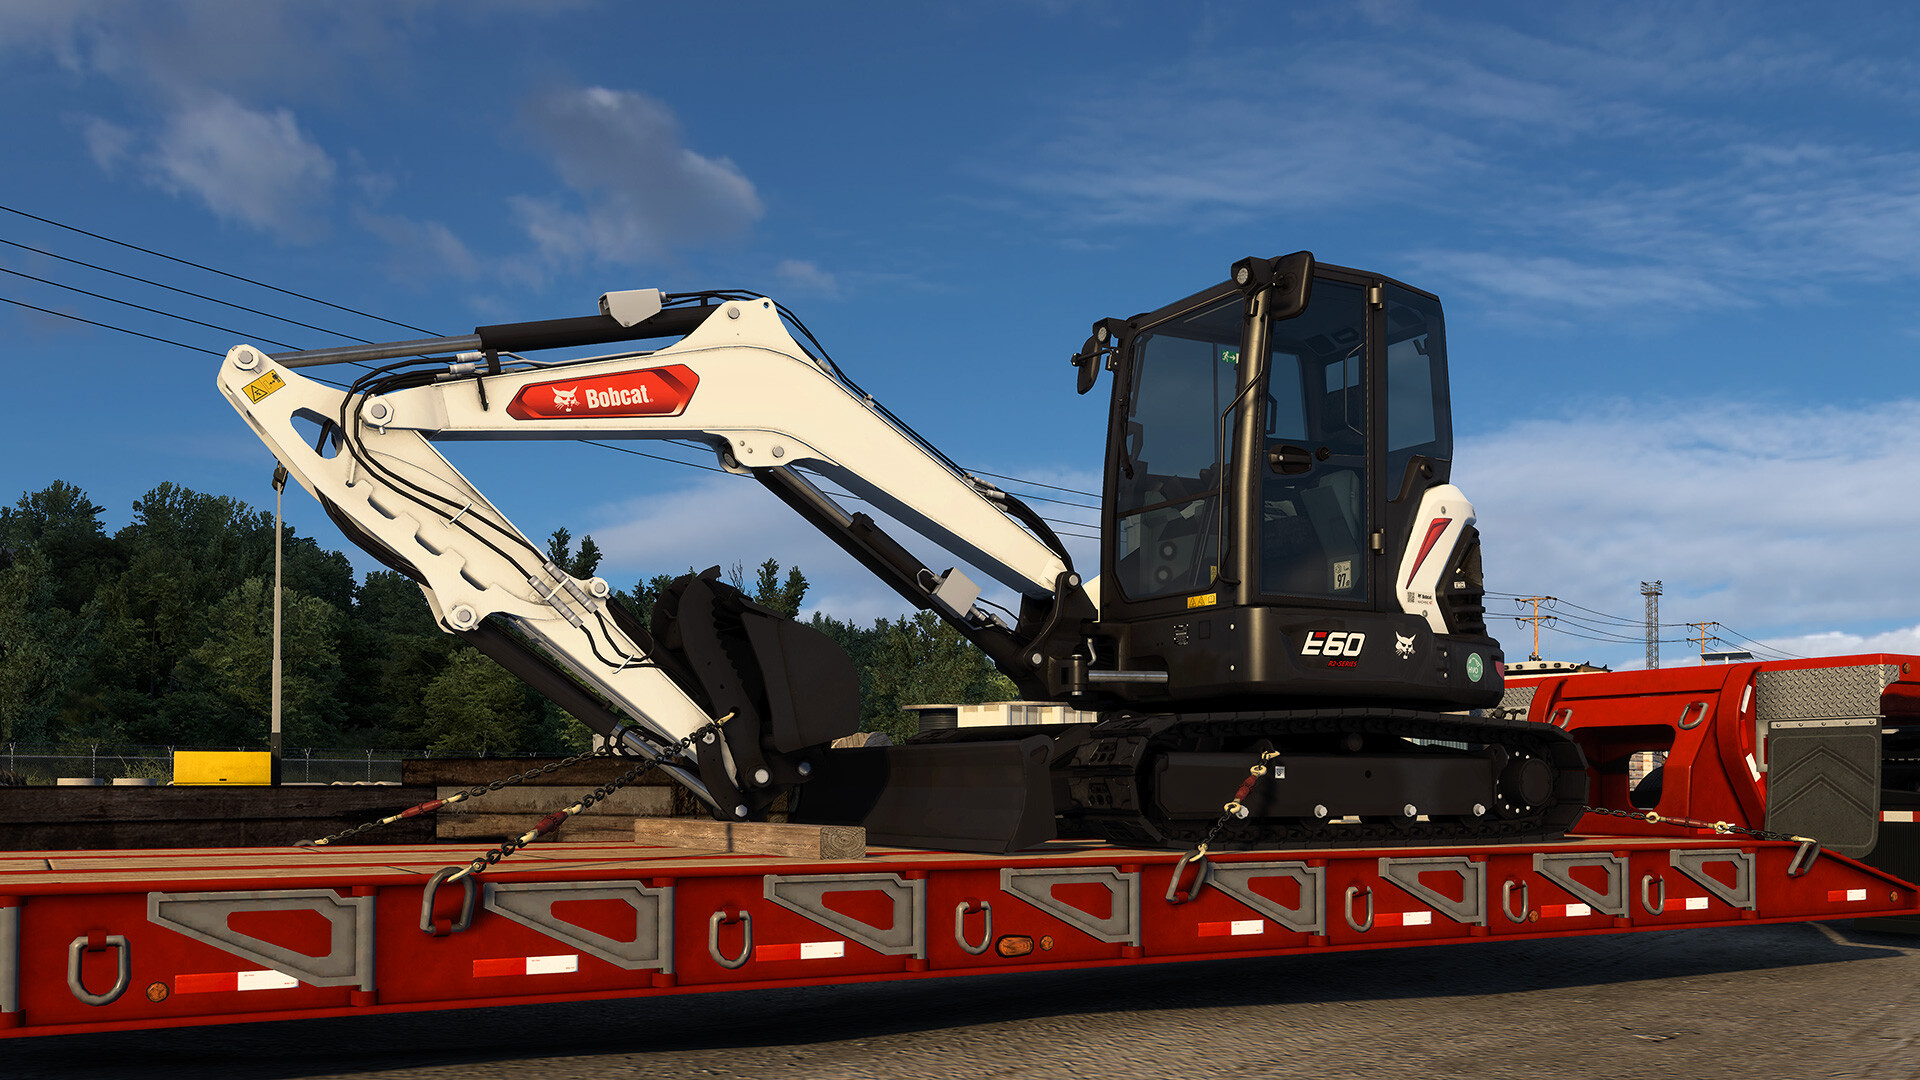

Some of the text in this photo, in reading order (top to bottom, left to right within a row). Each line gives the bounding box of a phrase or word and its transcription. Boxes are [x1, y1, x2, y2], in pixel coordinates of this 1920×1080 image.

[585, 385, 650, 409] Bobcat
[1337, 573, 1346, 588] 97
[1301, 631, 1366, 657] E60
[1327, 660, 1358, 668] R2-SERIES
